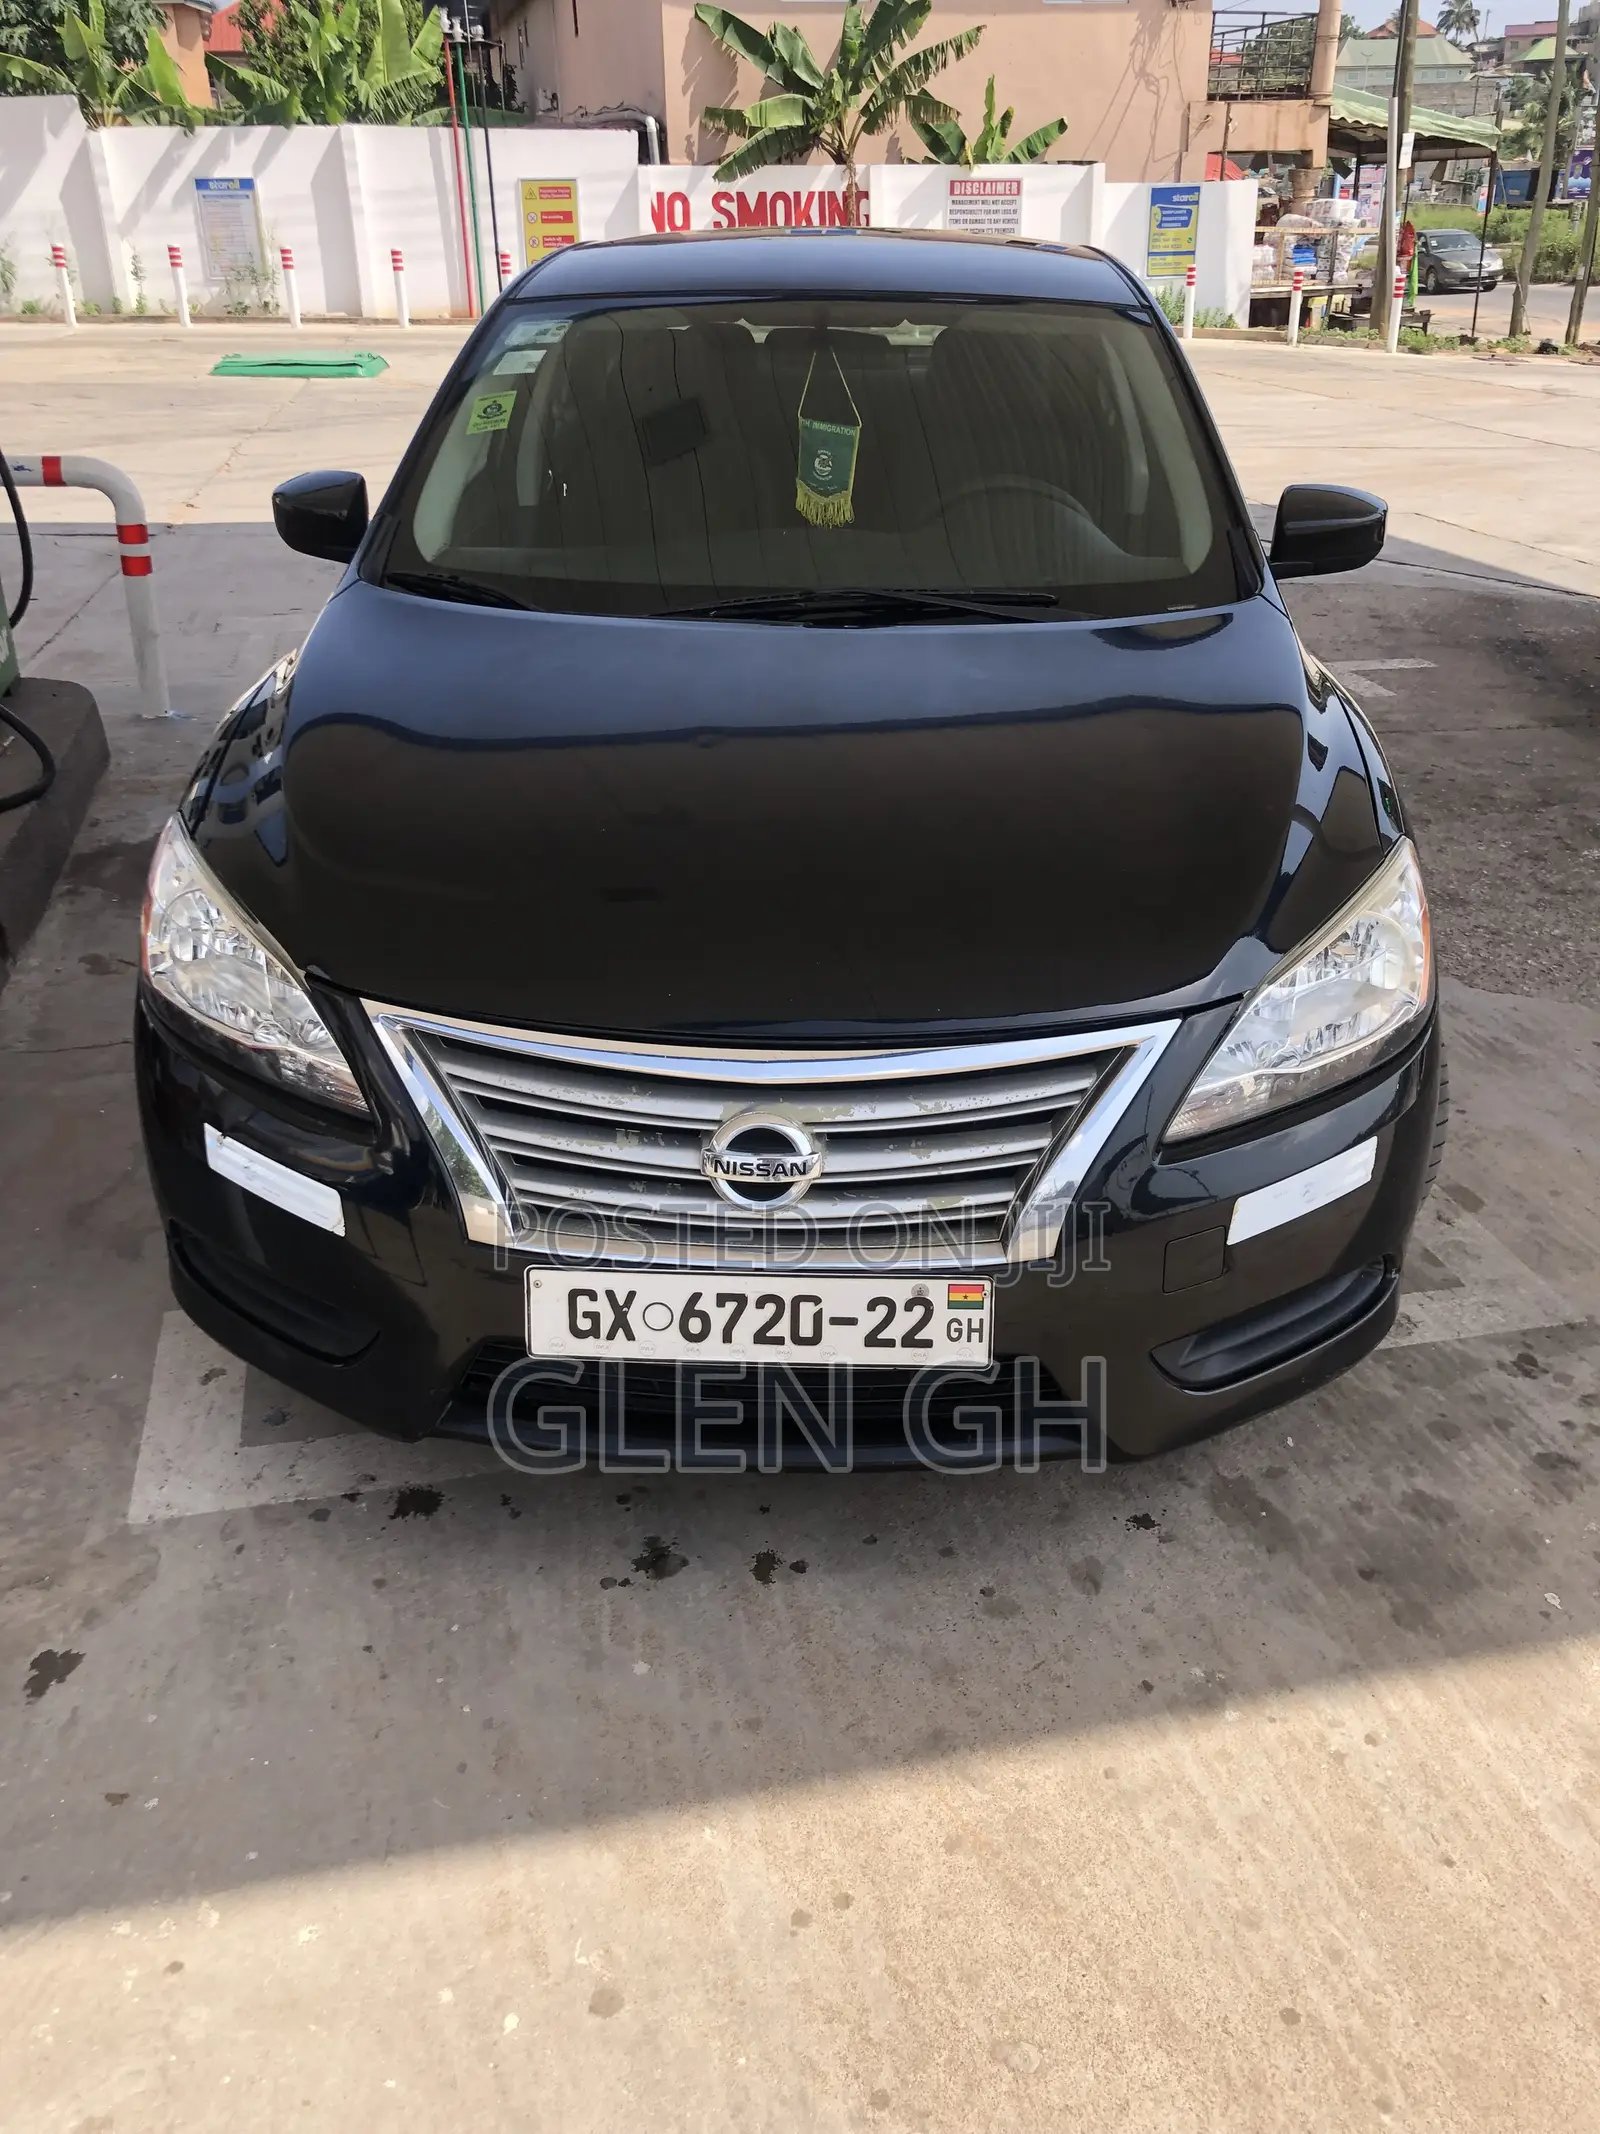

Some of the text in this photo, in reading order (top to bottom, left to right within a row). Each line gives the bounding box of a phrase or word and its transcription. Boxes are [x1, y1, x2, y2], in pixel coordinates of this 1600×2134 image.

[953, 181, 1018, 195] DISCLAIMER
[651, 190, 869, 234] NO SMOKING
[812, 421, 856, 436] IMMIGRATION
[713, 1159, 807, 1178] NISSAN
[567, 1288, 935, 1349] GX 6720-22
[946, 1317, 984, 1343] GH
